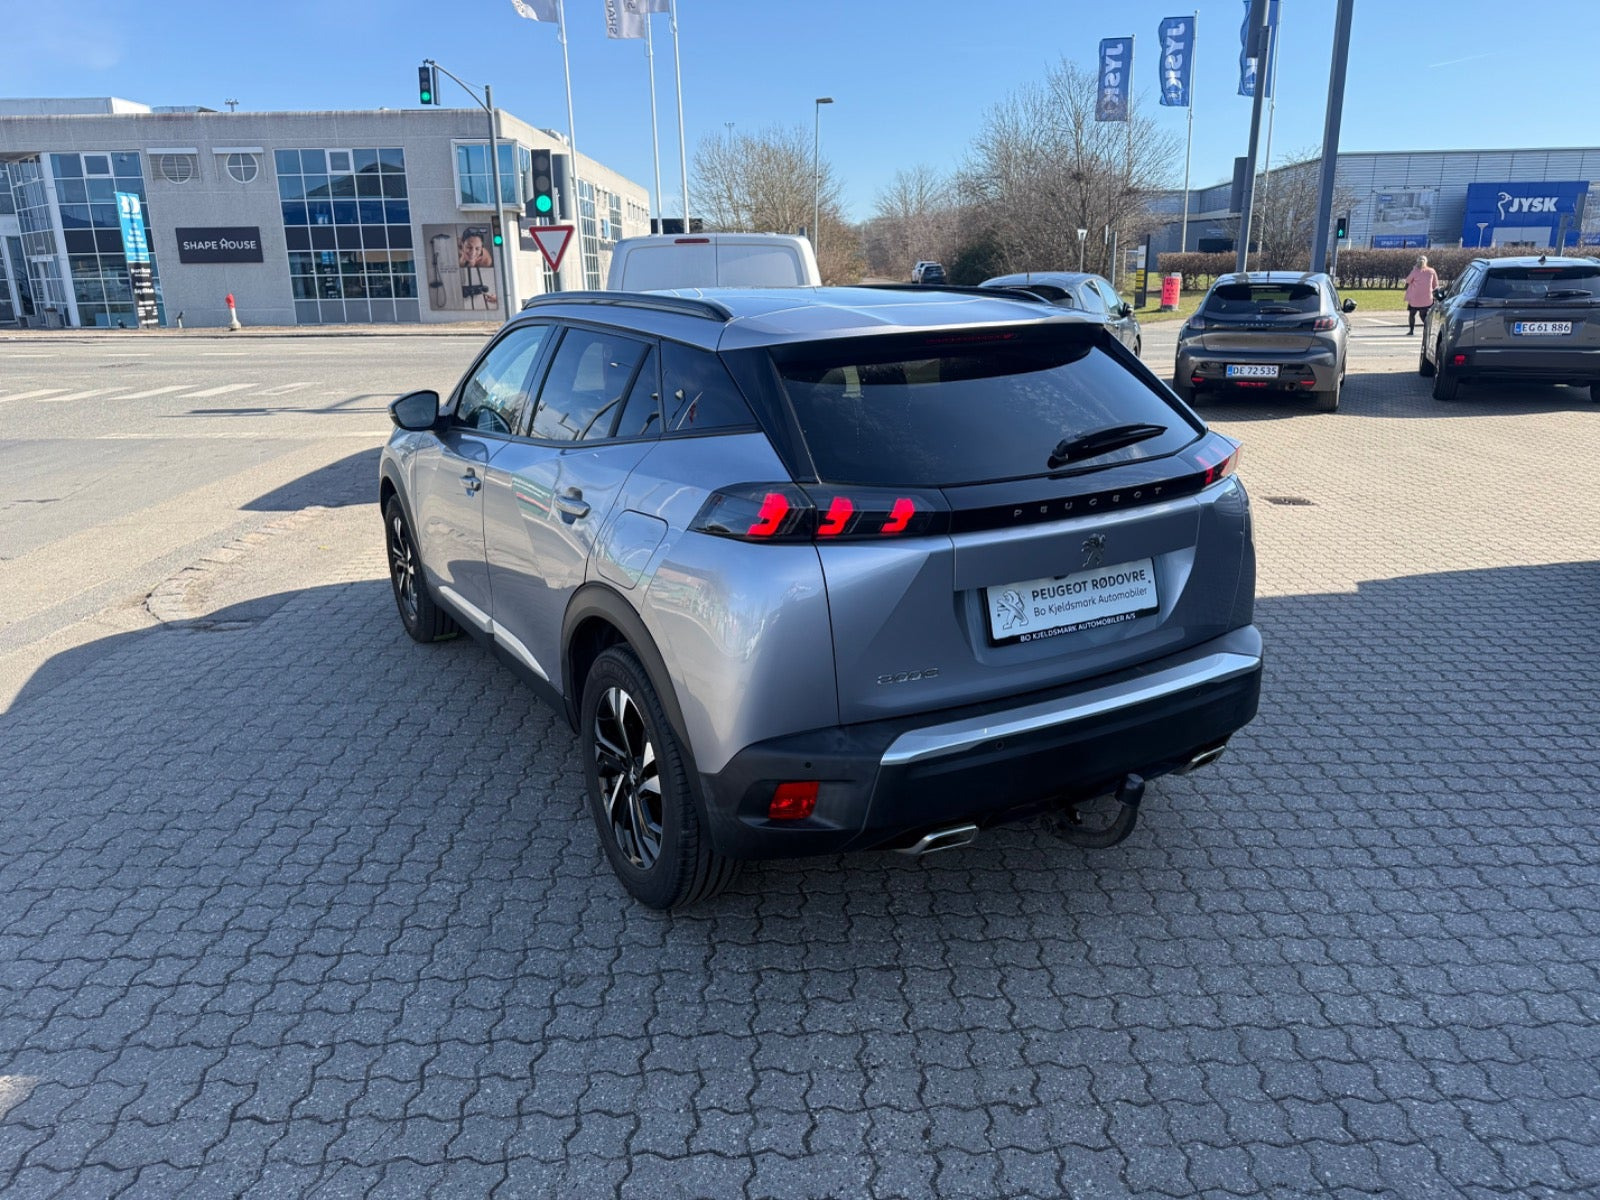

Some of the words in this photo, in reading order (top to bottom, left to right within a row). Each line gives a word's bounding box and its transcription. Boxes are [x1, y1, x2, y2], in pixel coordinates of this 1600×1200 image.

[1508, 197, 1559, 212] JYSK
[183, 241, 218, 250] SHAPE
[220, 238, 257, 249] HOUSE
[1522, 323, 1535, 332] EG
[1537, 323, 1548, 332] 61
[1551, 323, 1570, 332] 886
[1233, 367, 1244, 375] DE
[1247, 367, 1258, 375] 72
[1260, 366, 1277, 375] 535
[1014, 487, 1162, 517] PEUGEOT
[1032, 580, 1088, 602] PEUGEOT
[1092, 569, 1146, 590] RØDOVRE
[1034, 606, 1046, 617] Bo
[1048, 597, 1096, 616] Kjeldsmark
[1099, 587, 1148, 604] Automobiler
[1020, 633, 1031, 642] BO
[1032, 624, 1078, 640] KJELDSMARK
[1078, 614, 1125, 630] AUTOMOBILER
[1125, 612, 1136, 621] A/S
